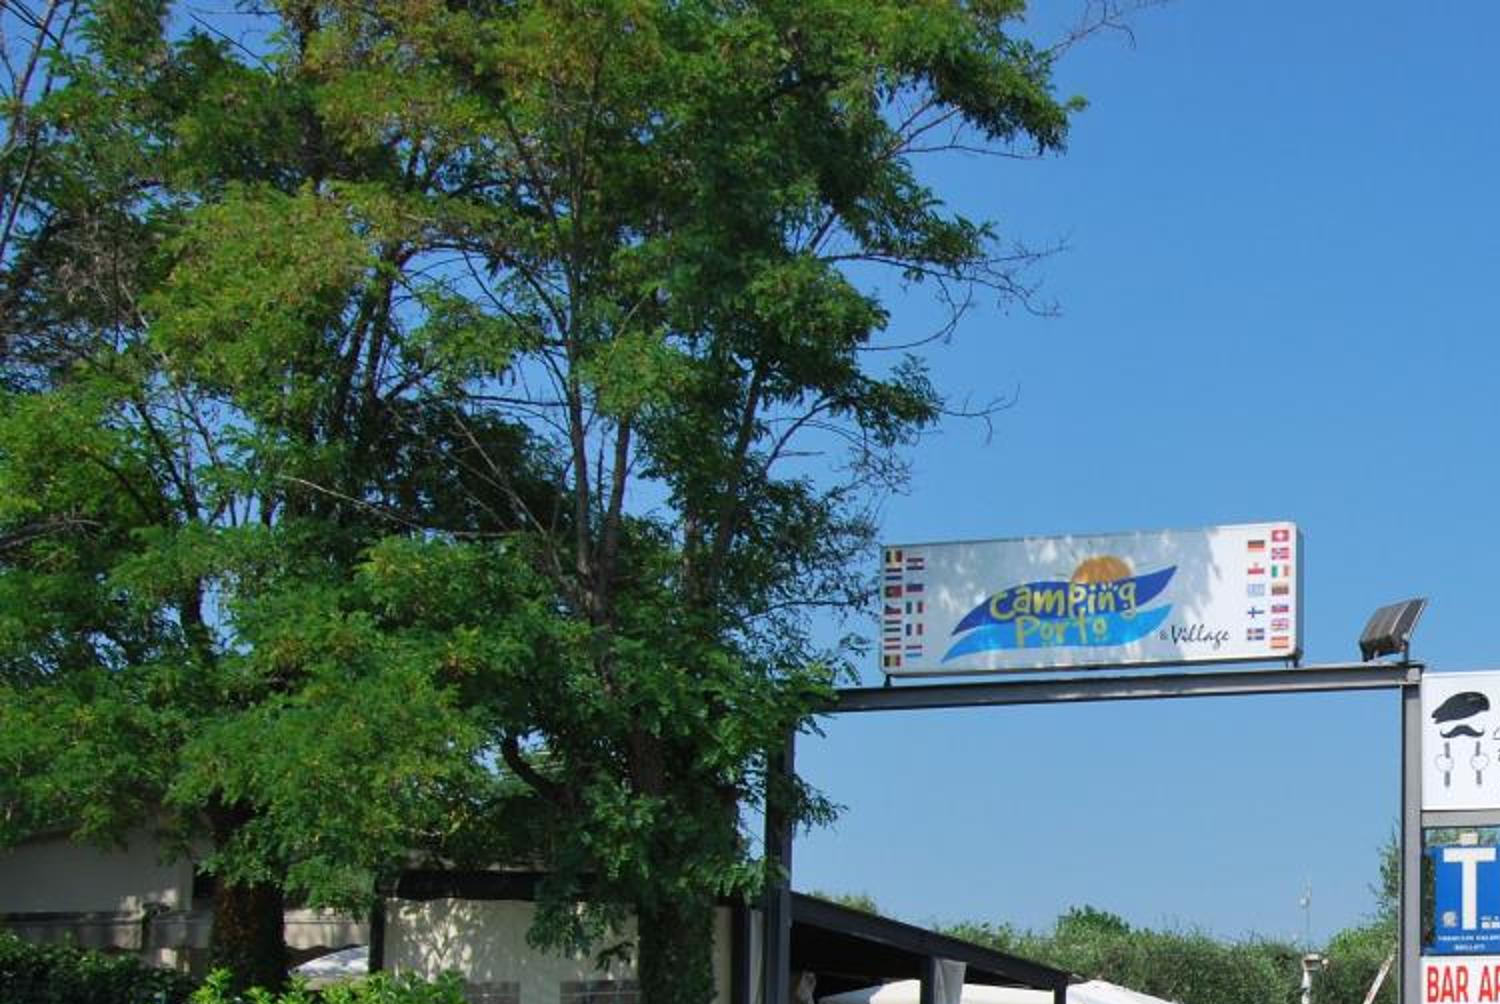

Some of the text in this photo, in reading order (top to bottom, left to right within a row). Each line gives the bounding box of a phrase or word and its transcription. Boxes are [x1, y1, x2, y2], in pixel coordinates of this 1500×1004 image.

[1015, 610, 1107, 649] Porto
[1171, 622, 1230, 650] Village
[1443, 847, 1497, 931] T
[1426, 965, 1469, 1004] BAR
